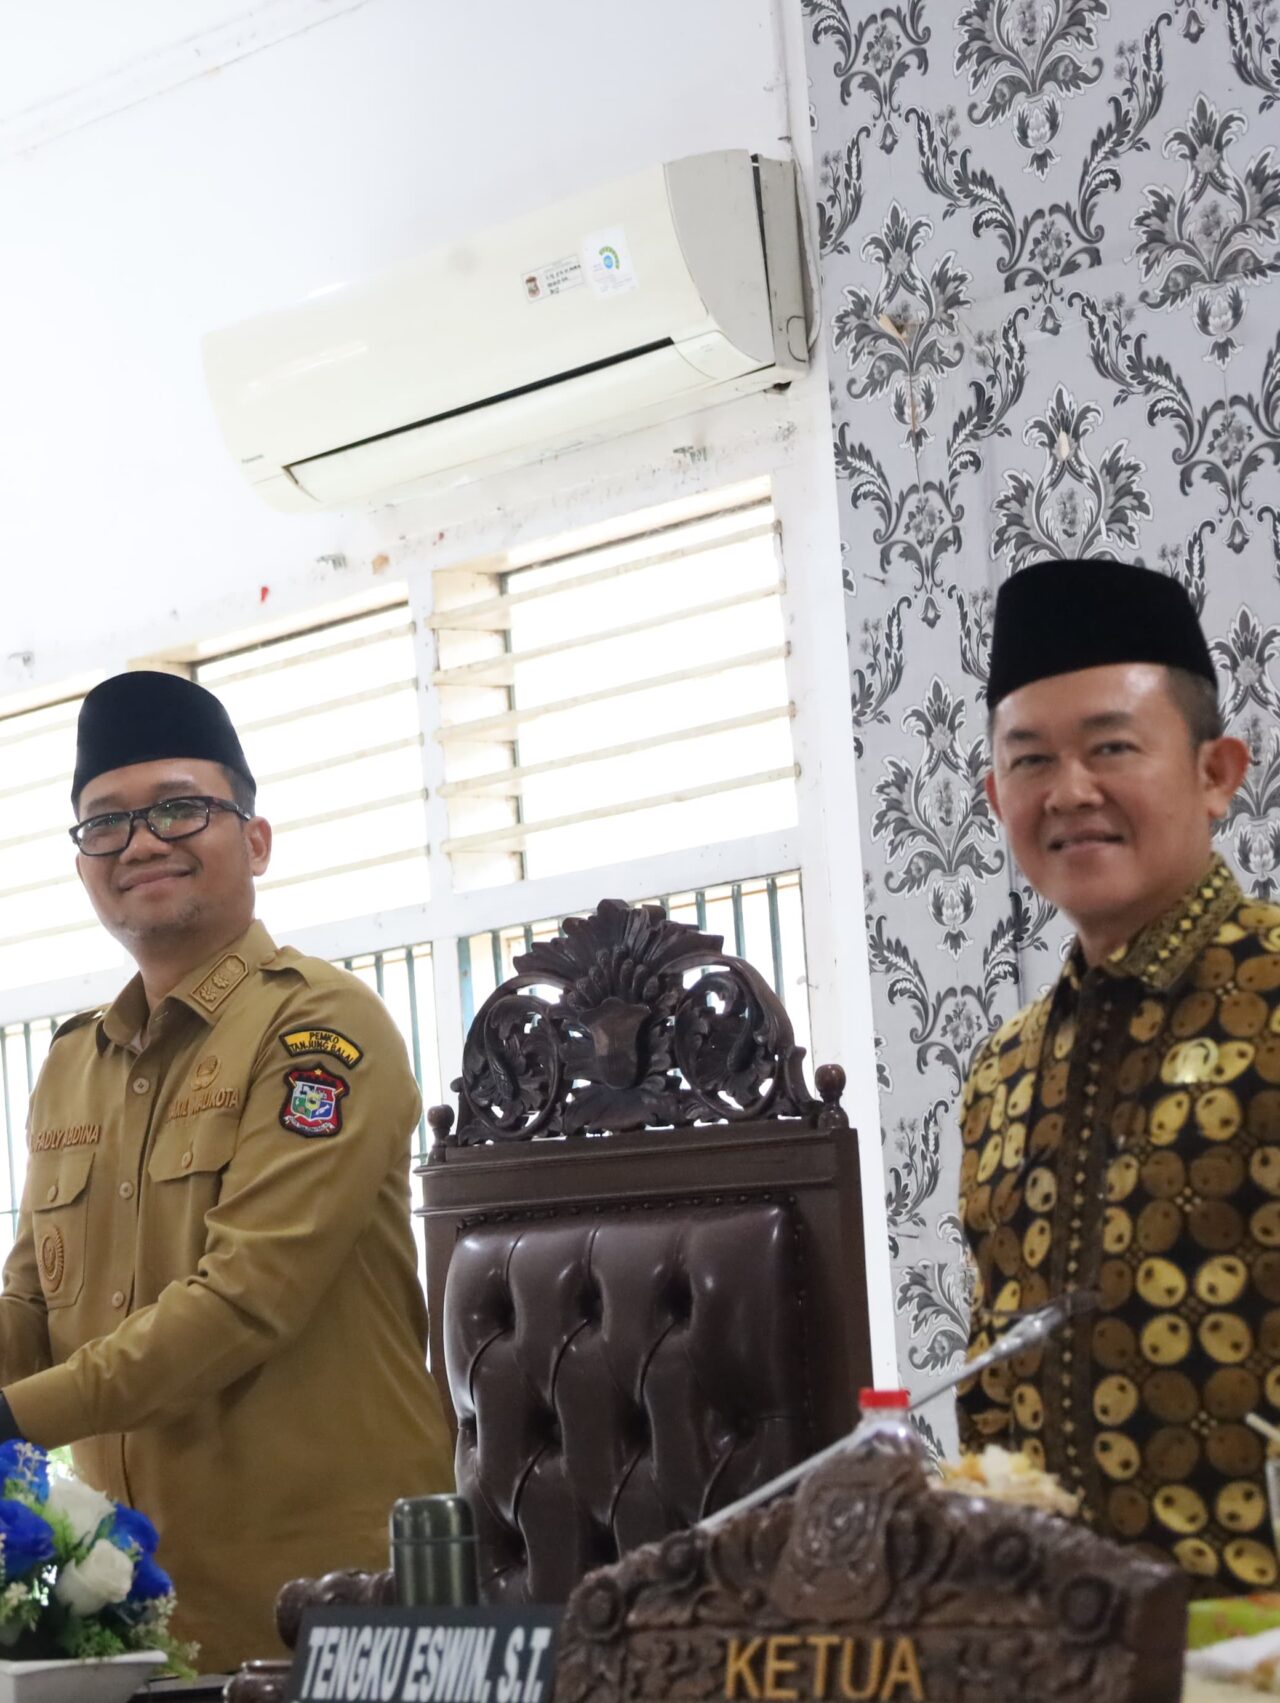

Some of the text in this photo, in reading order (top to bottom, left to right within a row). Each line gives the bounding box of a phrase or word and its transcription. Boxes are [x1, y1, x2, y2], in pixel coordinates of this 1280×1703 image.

[309, 1030, 340, 1045] PEMKO
[330, 1043, 354, 1065] BALAI
[301, 1626, 410, 1700] TENGKU
[724, 1634, 925, 1701] KETUA
